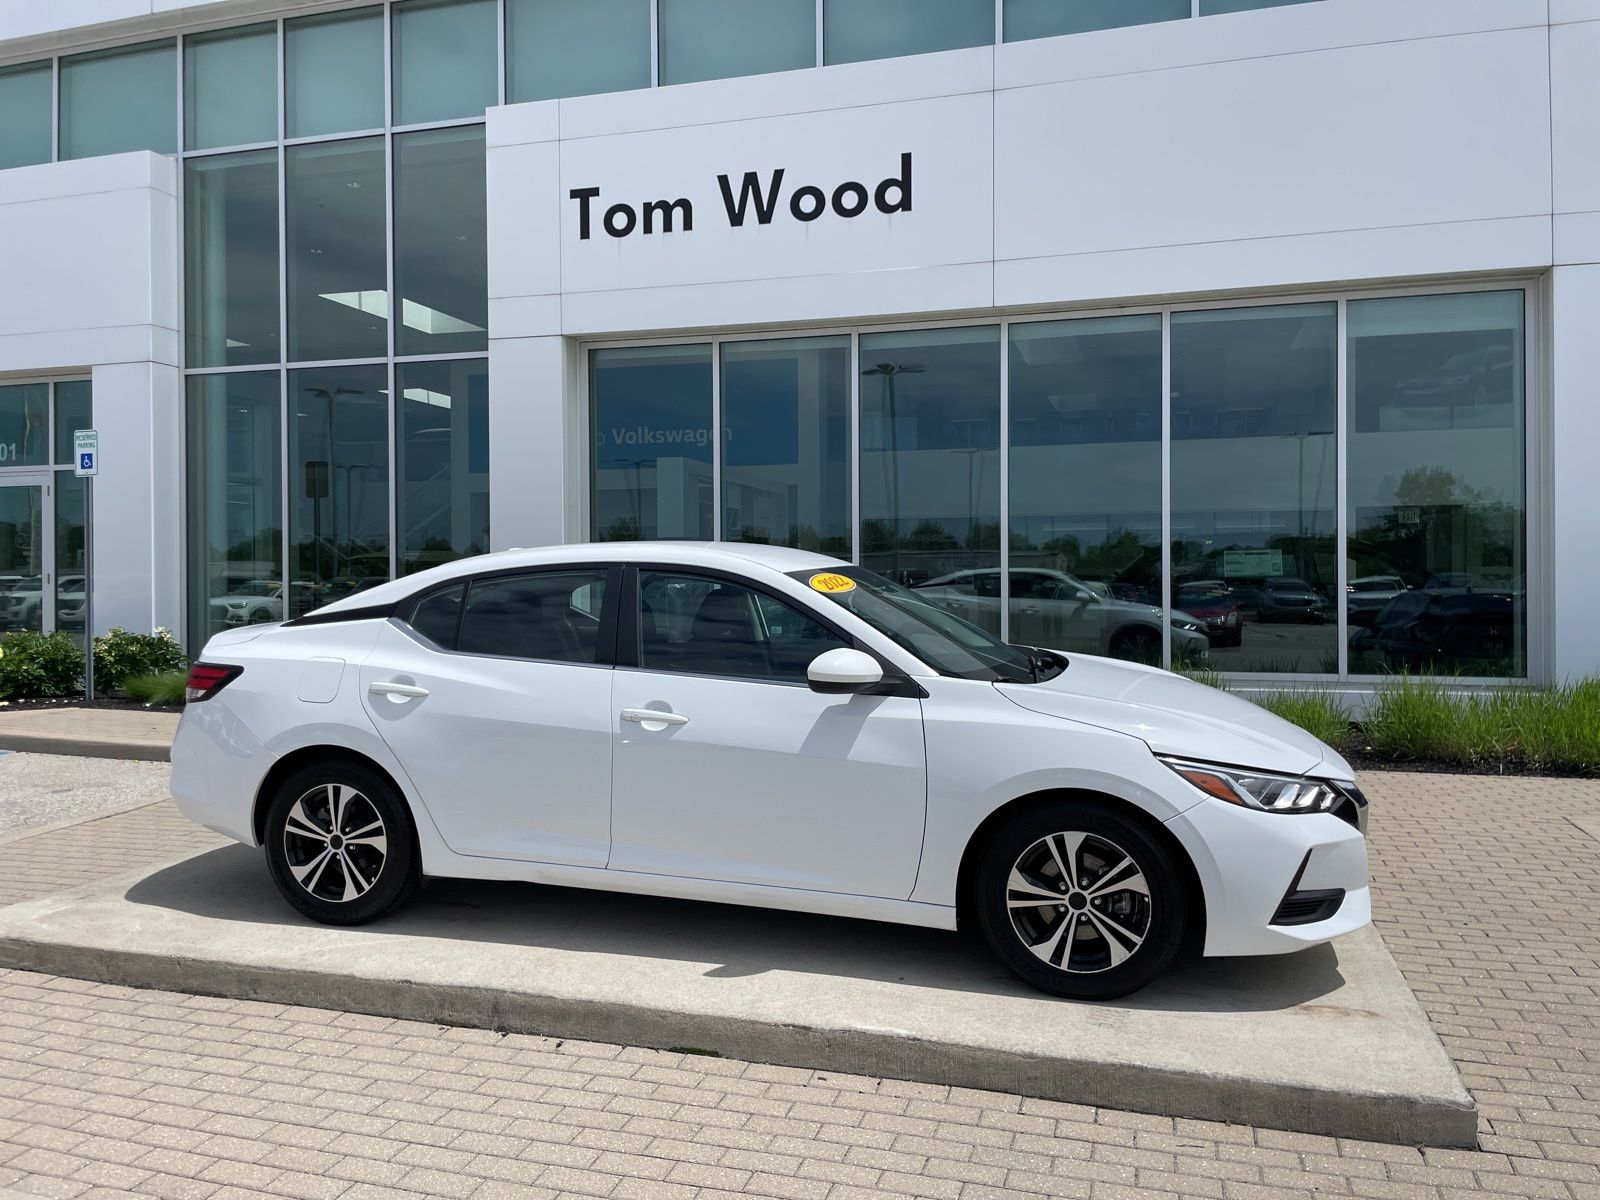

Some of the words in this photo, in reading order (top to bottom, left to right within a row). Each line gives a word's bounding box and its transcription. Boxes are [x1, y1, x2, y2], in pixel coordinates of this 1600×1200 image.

[569, 186, 693, 240] Tom
[716, 152, 913, 228] Wood
[817, 575, 850, 591] 2022
